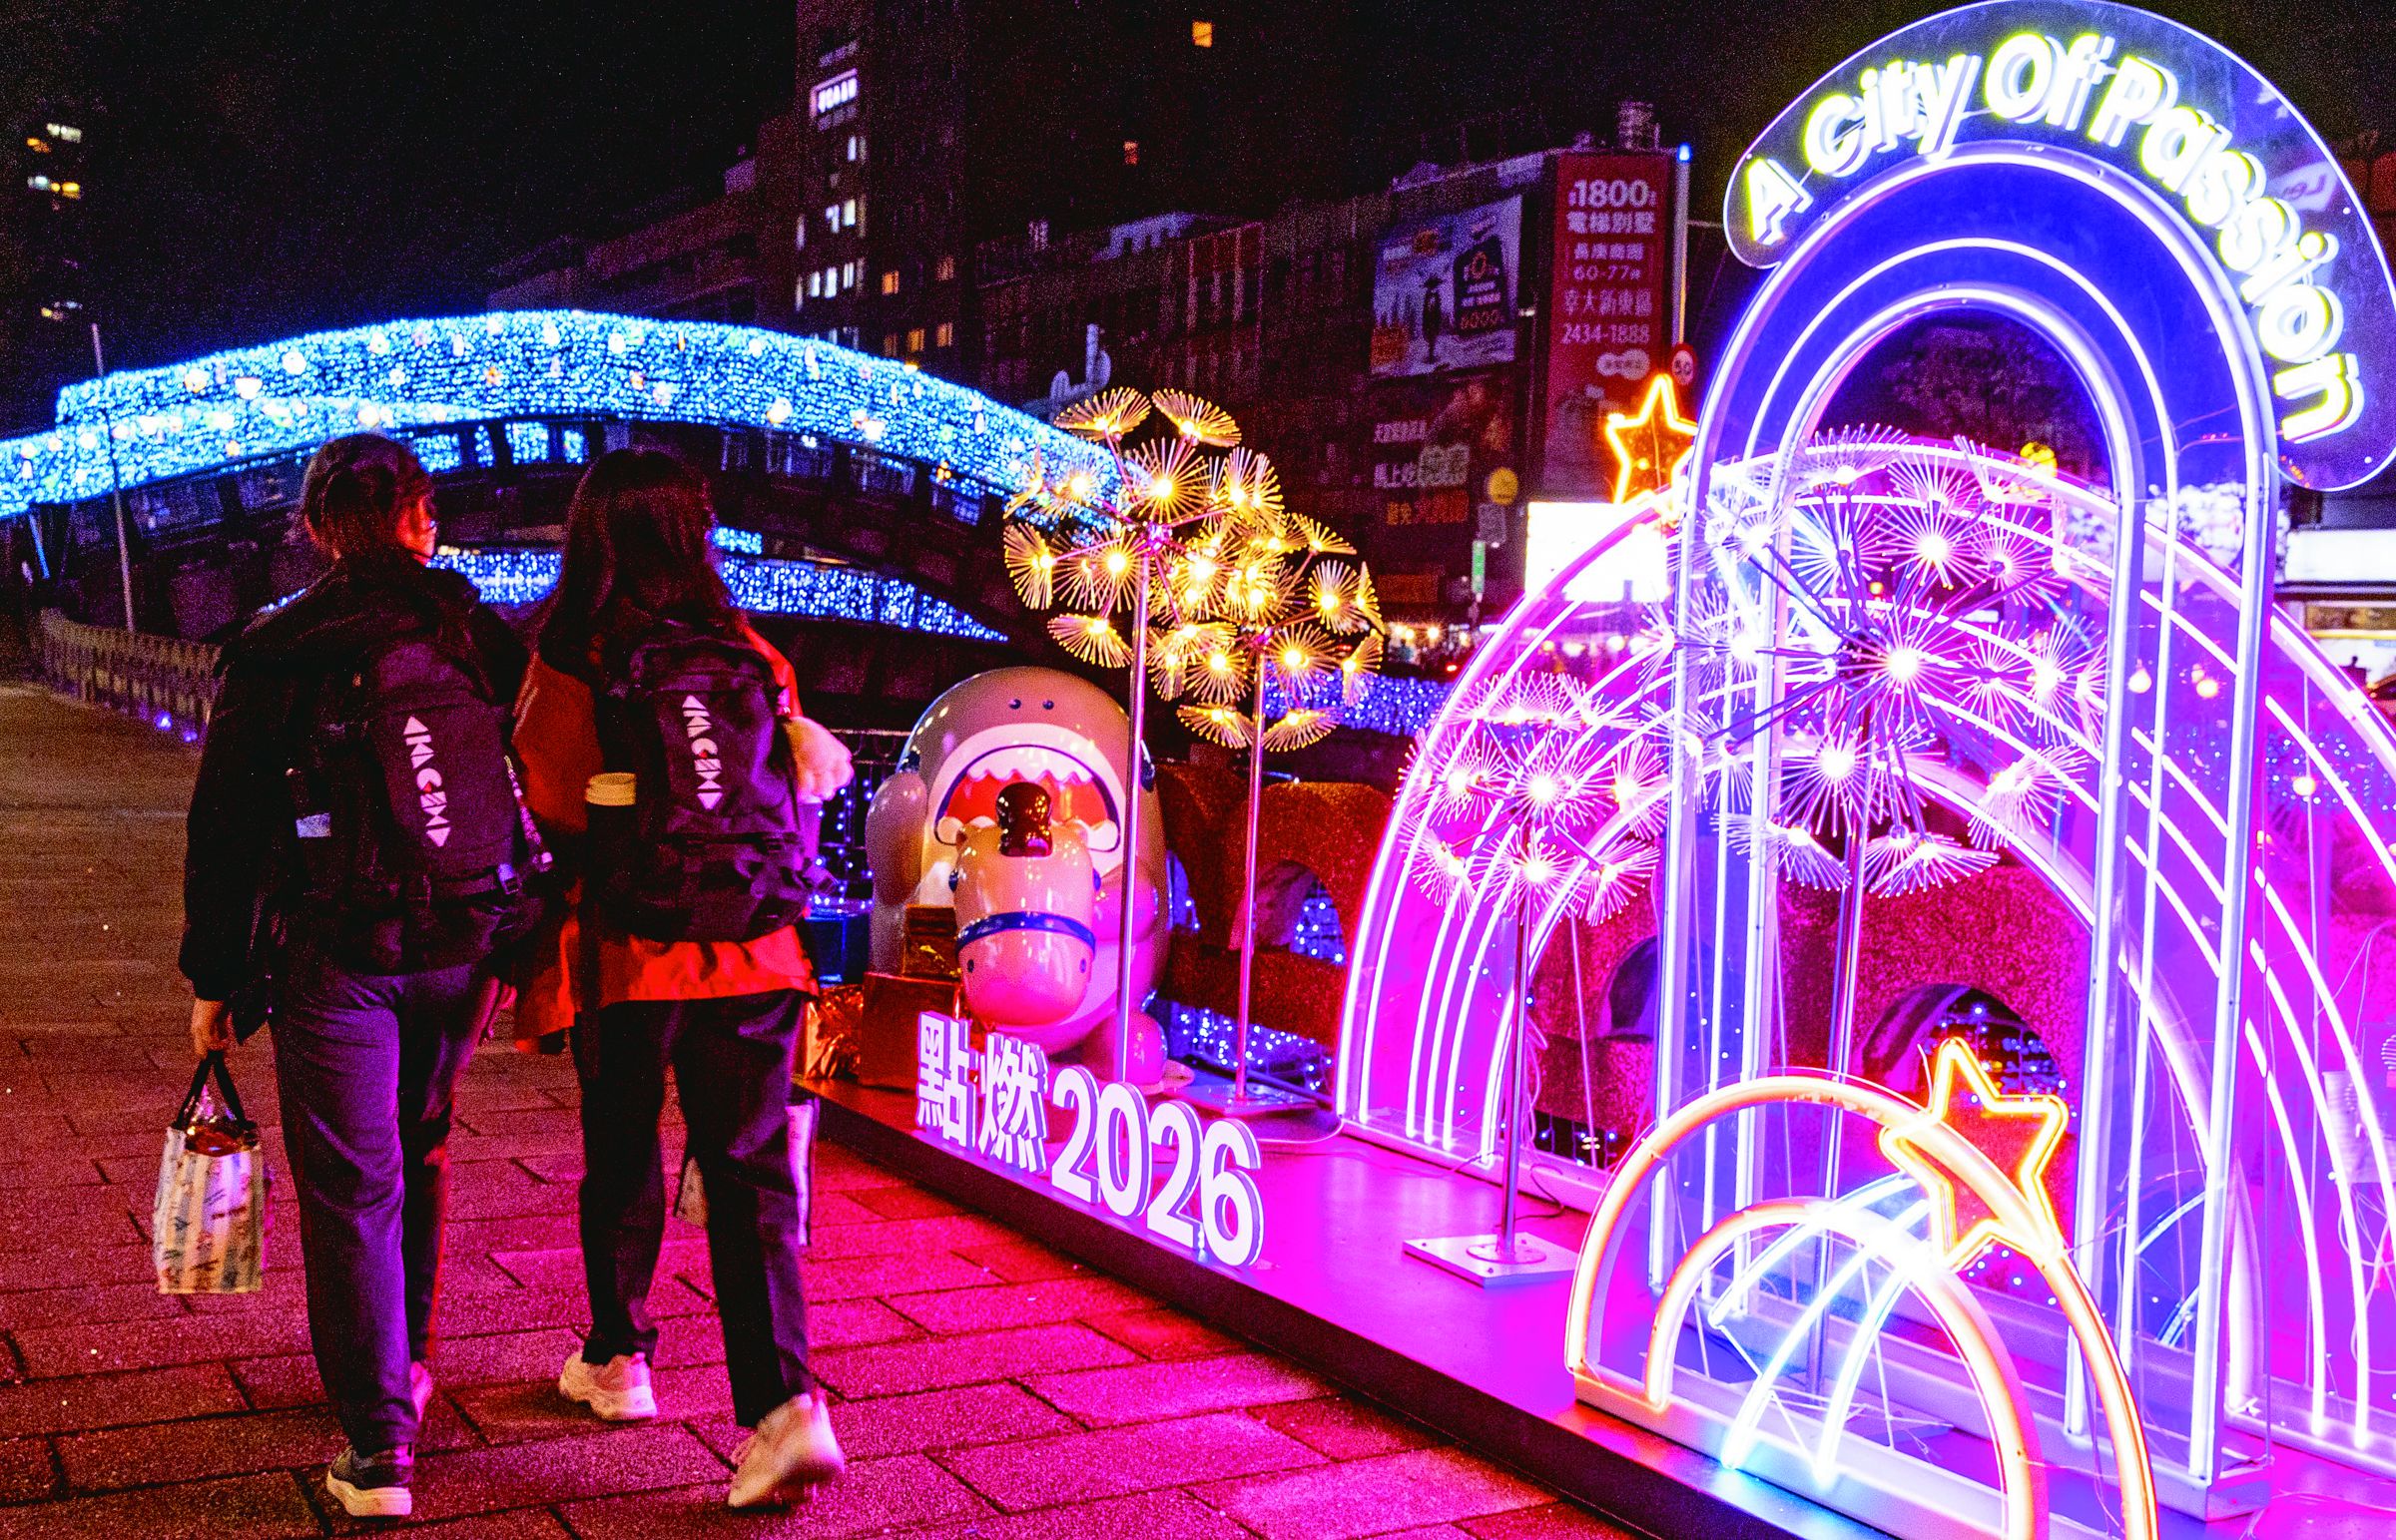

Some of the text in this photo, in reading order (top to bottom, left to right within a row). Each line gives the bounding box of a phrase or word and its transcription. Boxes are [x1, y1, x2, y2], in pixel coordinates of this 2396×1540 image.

[1743, 32, 2365, 442] A City Of Passion
[916, 1010, 1265, 1268] 點燃 2026
